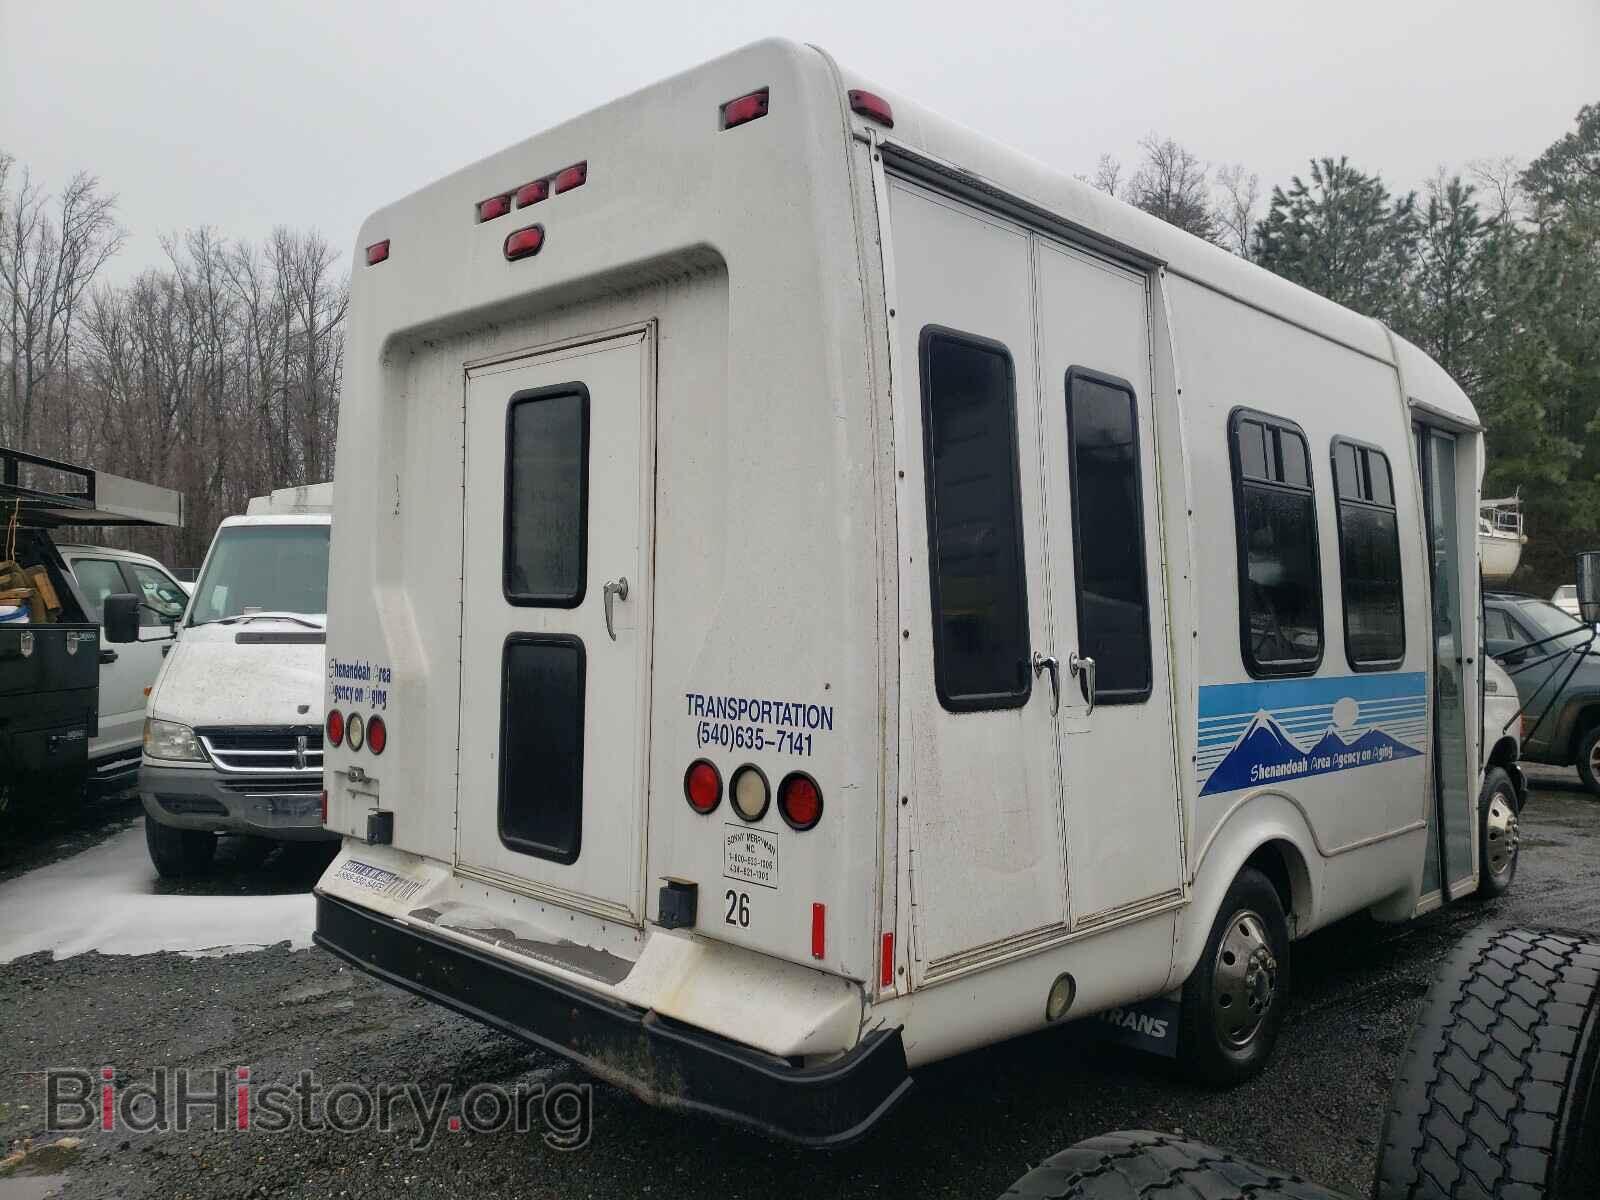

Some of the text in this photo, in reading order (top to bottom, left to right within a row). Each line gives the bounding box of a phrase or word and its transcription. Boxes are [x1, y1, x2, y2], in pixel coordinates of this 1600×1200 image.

[328, 658, 370, 680] Shenandoah
[355, 688, 363, 703] on
[686, 694, 833, 730] TRANSPORTATION
[697, 720, 812, 756] (540)635-7141
[1250, 744, 1393, 782] Shenandoah Area Agency on Aging
[725, 890, 751, 927] 26
